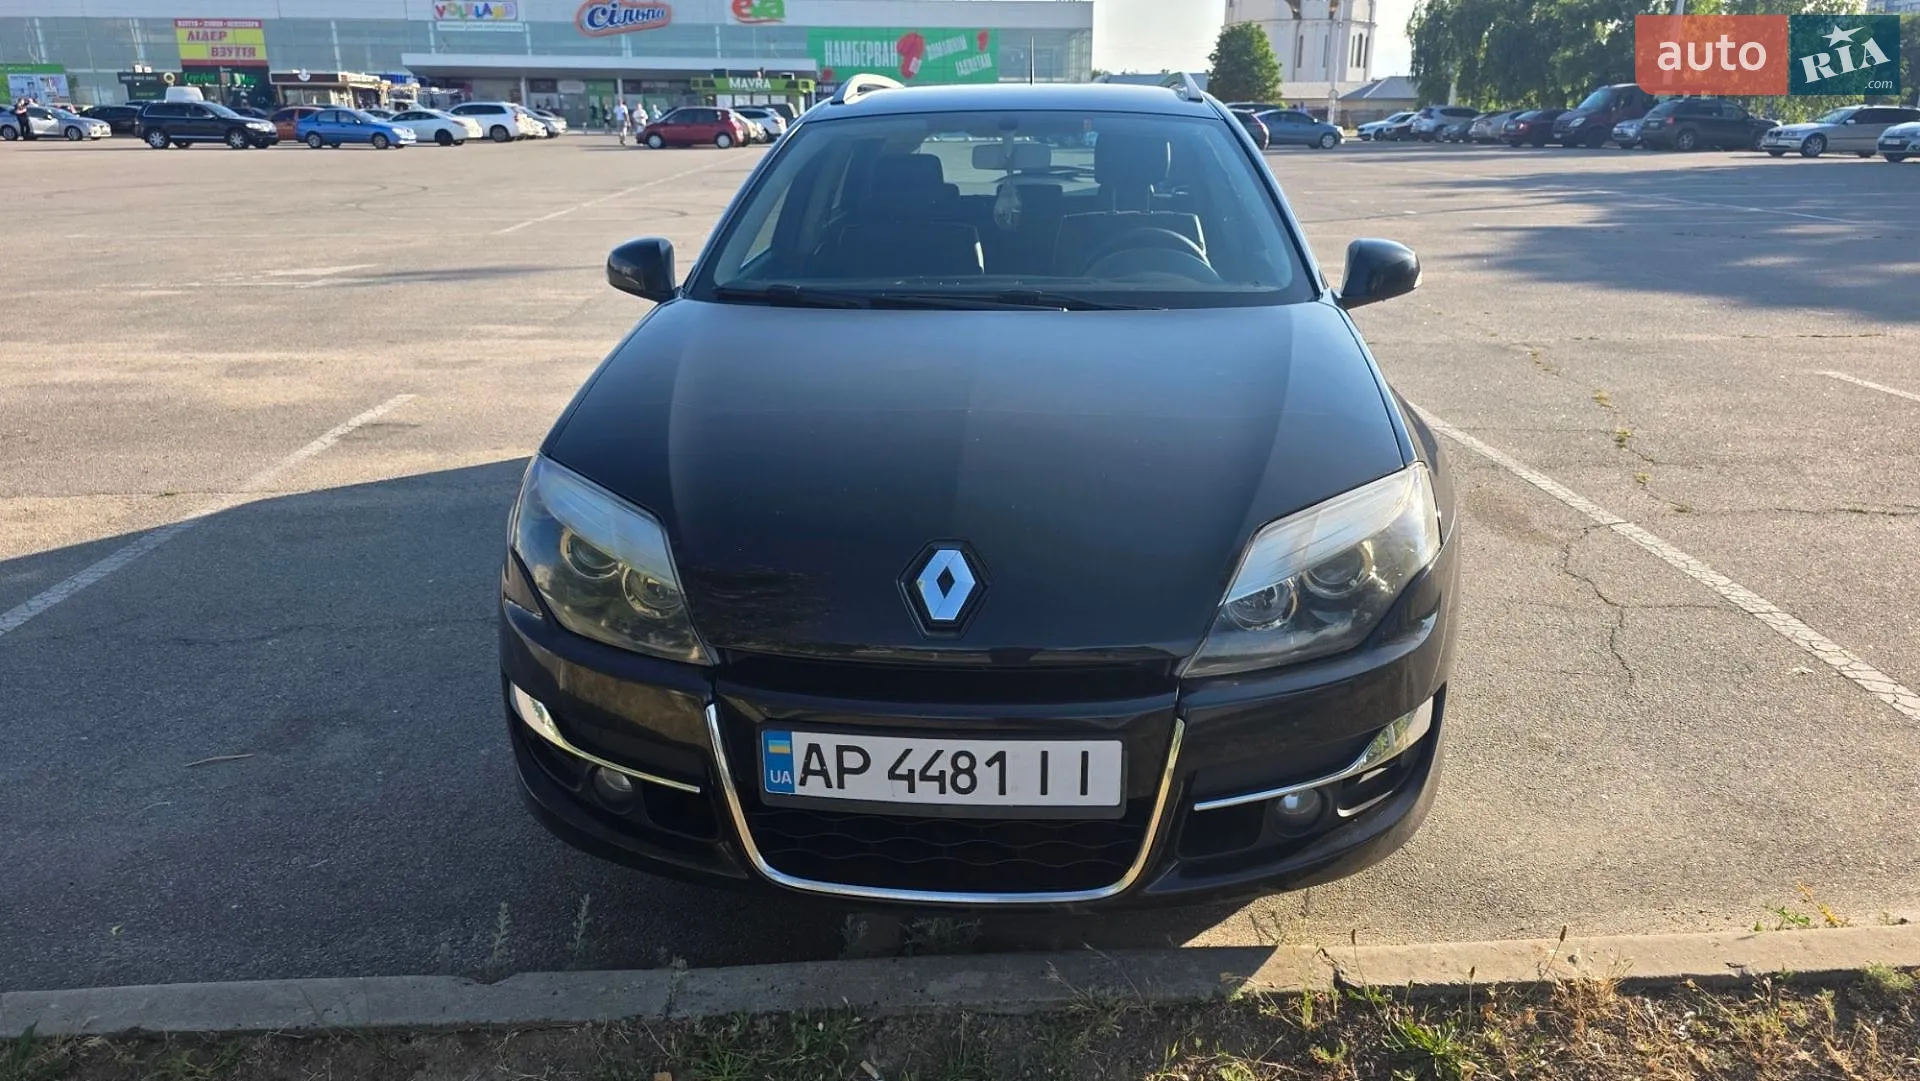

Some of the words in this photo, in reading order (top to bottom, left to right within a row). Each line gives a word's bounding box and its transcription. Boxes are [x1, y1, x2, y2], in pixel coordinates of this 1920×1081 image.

[586, 3, 665, 29] Сільпо
[187, 30, 228, 41] ЛІДЕР
[211, 46, 256, 57] ВЗУТТЯ
[824, 40, 899, 67] НАМБЕРВАН
[769, 770, 792, 785] UA
[798, 742, 871, 789] AP
[887, 748, 1007, 796] 4481
